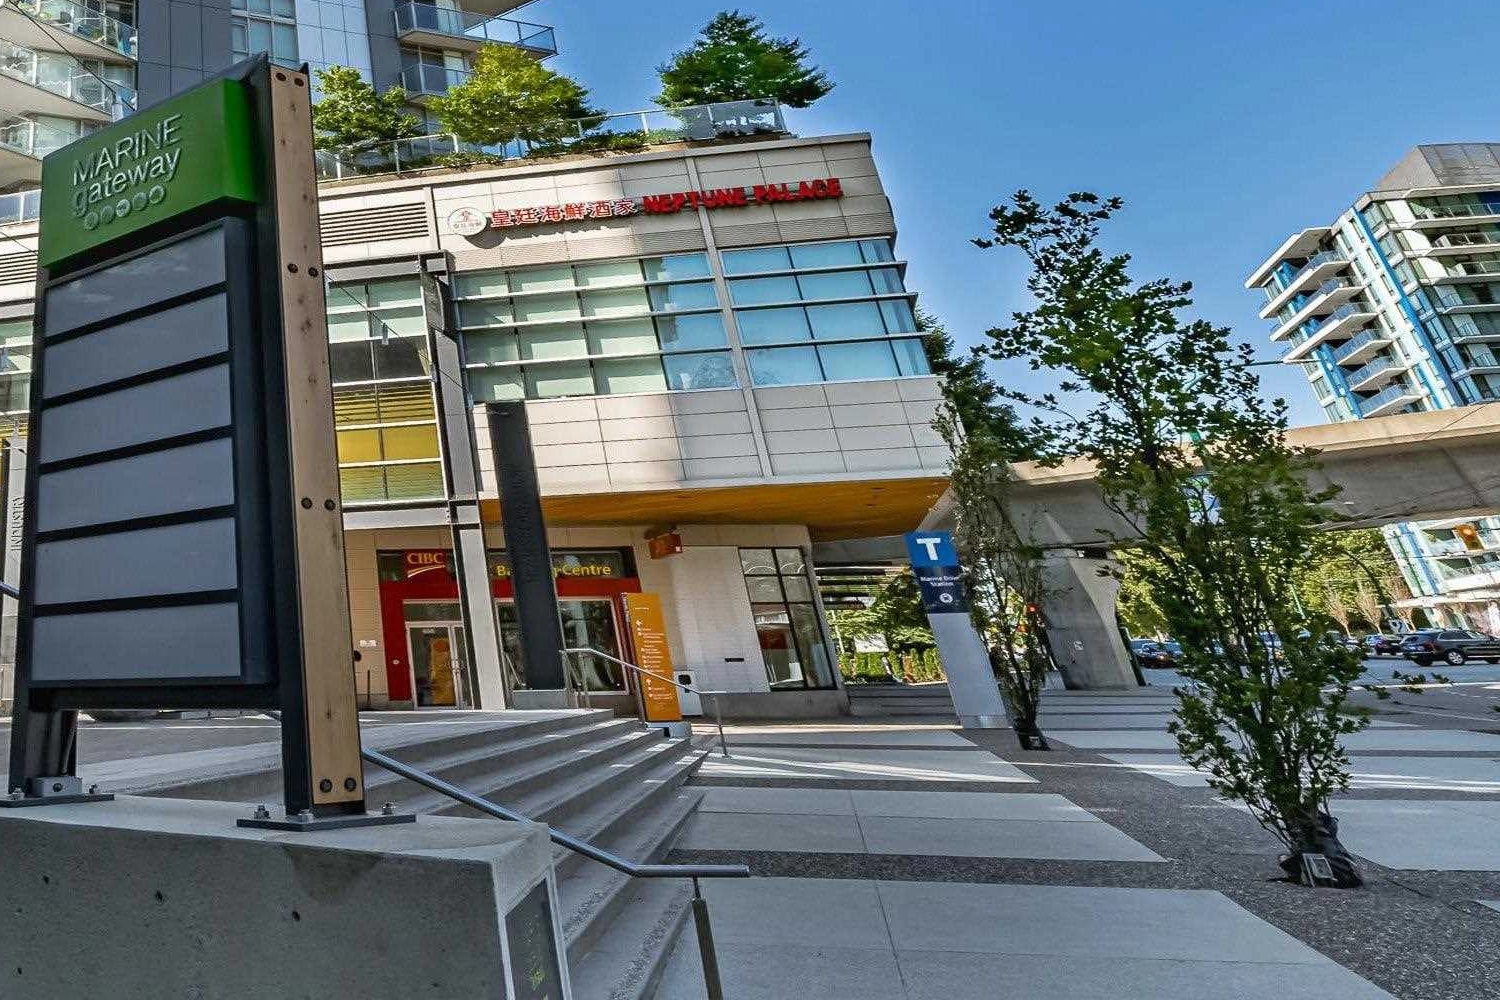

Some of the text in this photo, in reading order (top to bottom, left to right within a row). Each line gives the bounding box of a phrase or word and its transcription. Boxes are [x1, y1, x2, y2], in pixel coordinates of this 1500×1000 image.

[73, 114, 181, 186] MARINE
[72, 148, 181, 218] gateway
[643, 178, 843, 214] NEPTUNE PALACE
[407, 553, 444, 564] CIBC
[916, 538, 941, 560] T
[562, 564, 613, 576] Centre
